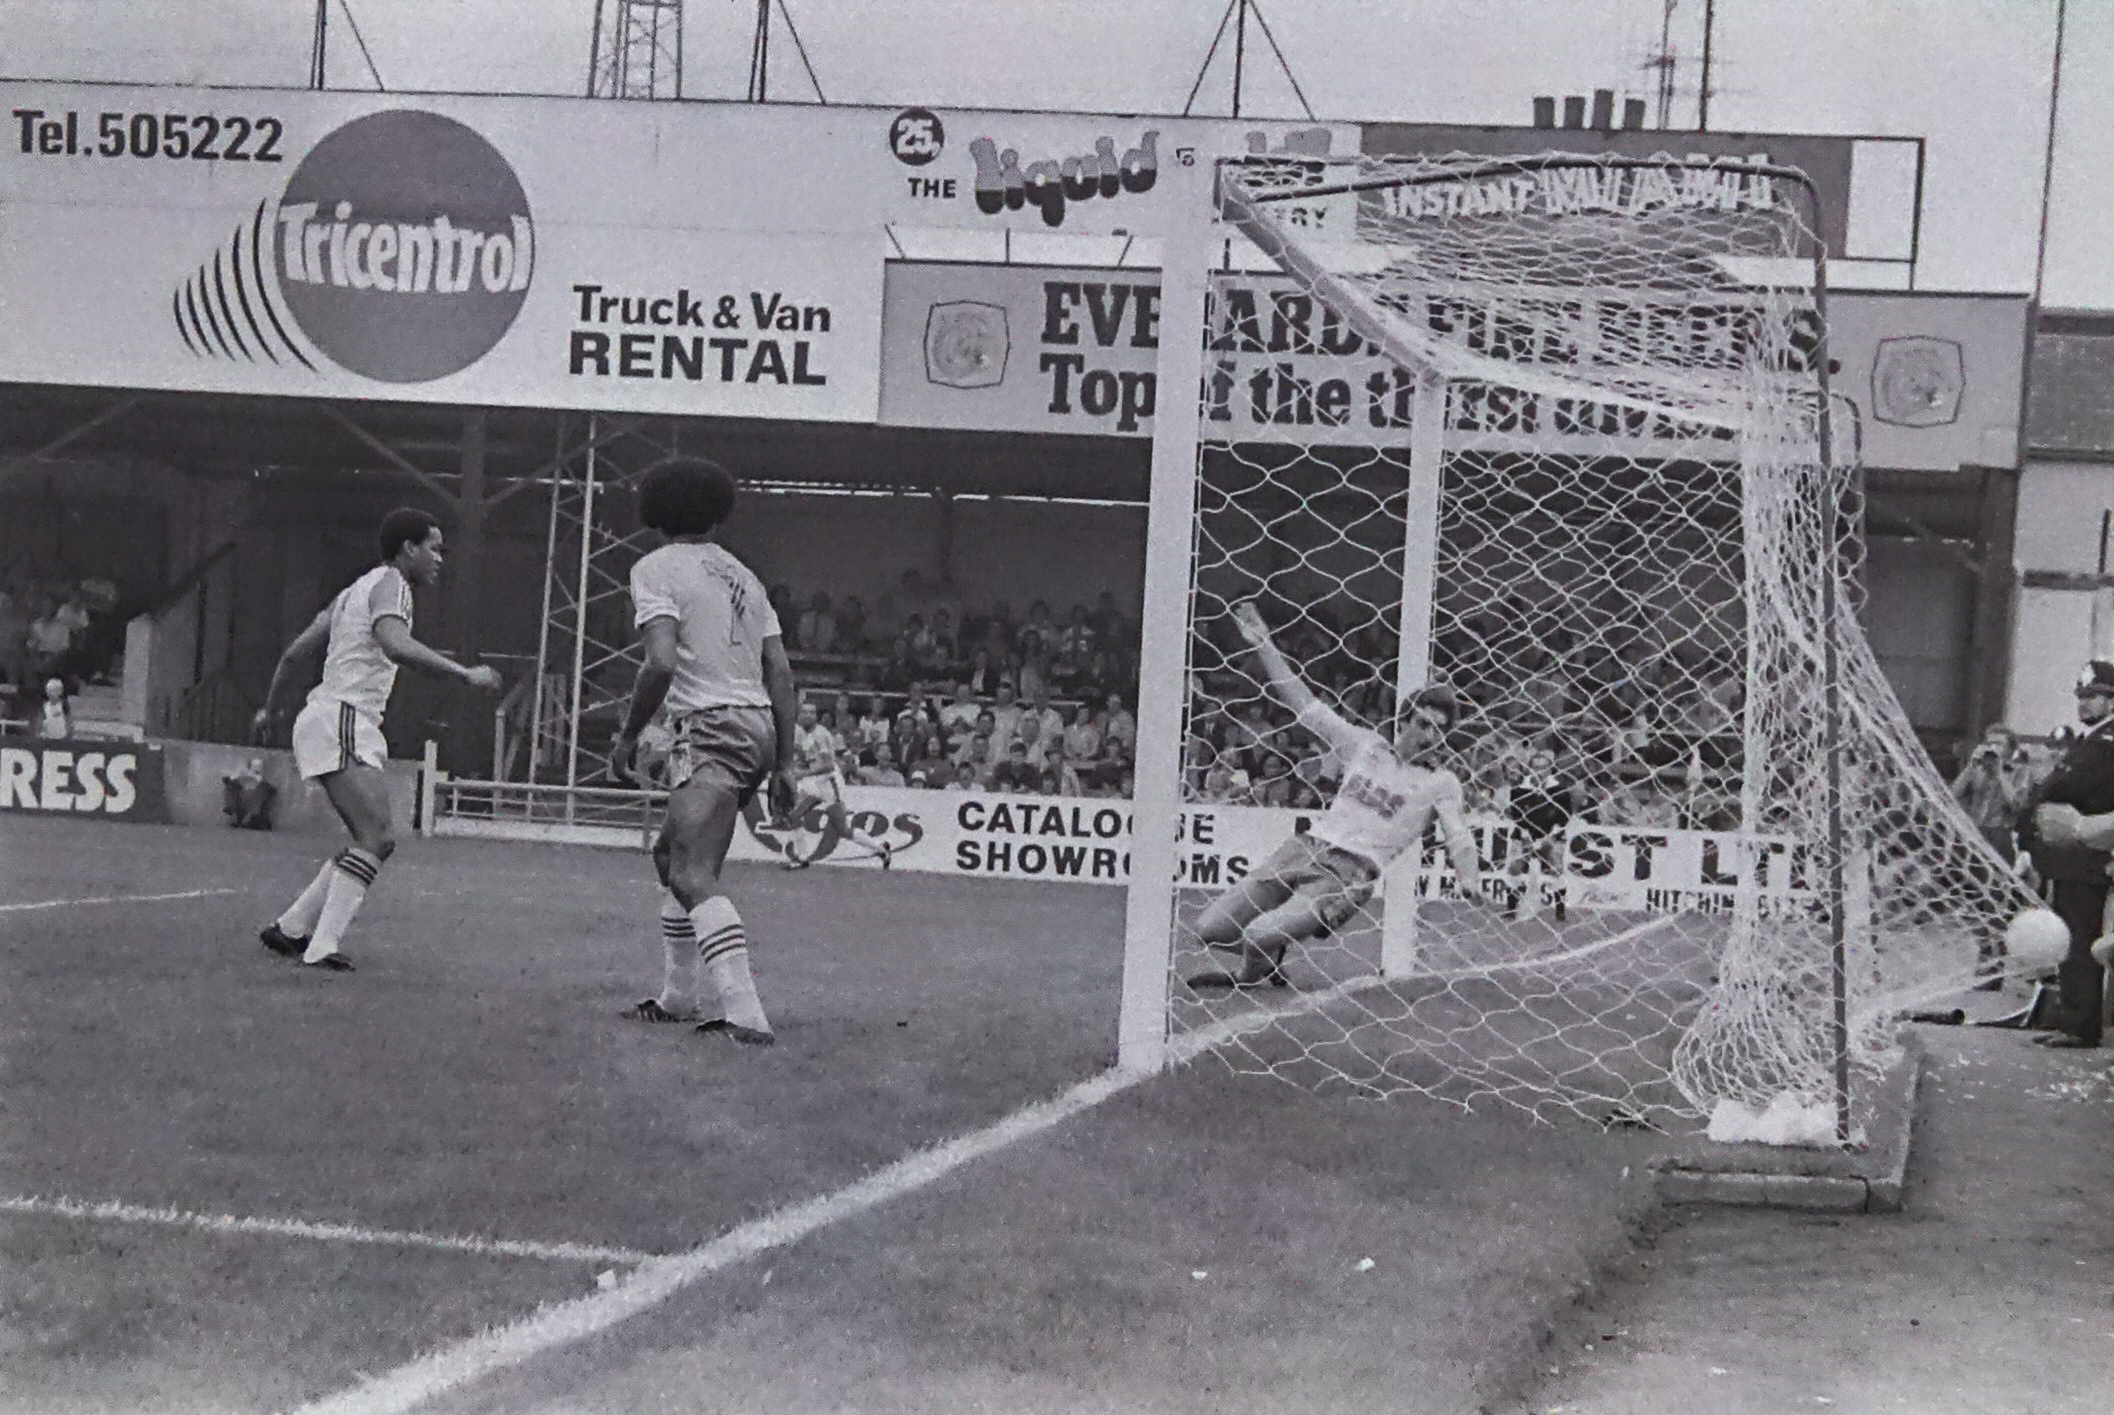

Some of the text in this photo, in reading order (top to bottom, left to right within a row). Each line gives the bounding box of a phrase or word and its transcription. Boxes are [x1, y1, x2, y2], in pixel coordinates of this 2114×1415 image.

[908, 178, 956, 199] THE
[278, 200, 530, 292] Tricentrol
[573, 285, 831, 332] Truck & Van
[1041, 281, 1400, 356] EVEARD
[568, 331, 826, 385] RENTAL
[1039, 353, 1157, 431] Top
[1248, 363, 1350, 425] the
[0, 748, 137, 813] RESS
[958, 801, 1214, 844] CATALOE
[957, 841, 1249, 885] SHOWRMS
